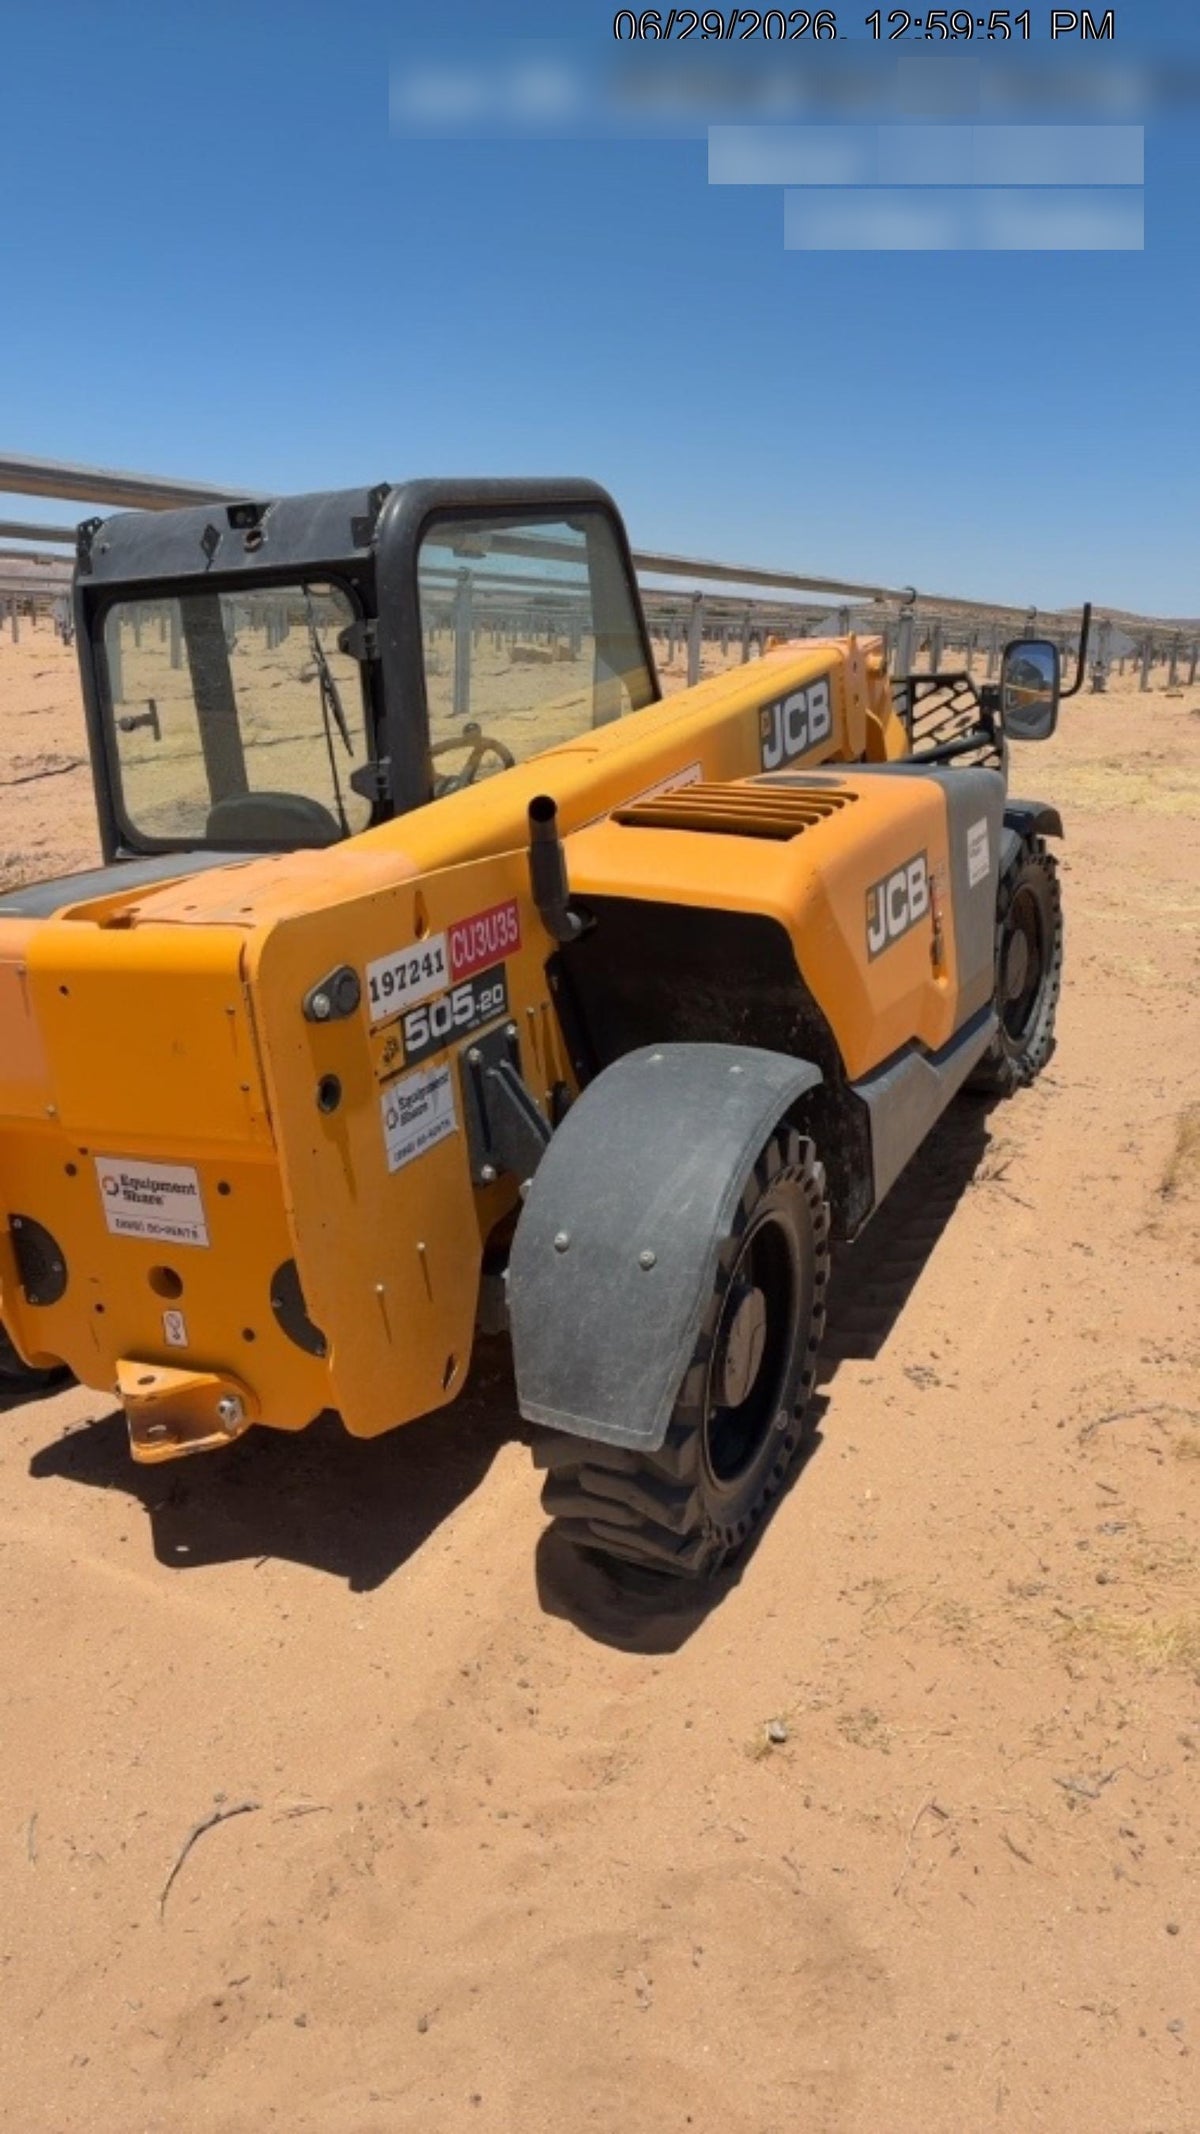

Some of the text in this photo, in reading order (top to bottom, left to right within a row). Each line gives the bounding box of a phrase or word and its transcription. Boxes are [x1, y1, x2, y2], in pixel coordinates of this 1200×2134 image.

[763, 679, 831, 771] JCB
[868, 857, 930, 953] JCB
[452, 906, 519, 968] CU3U35
[369, 948, 445, 1001] 197241
[121, 1174, 197, 1195] Equipment
